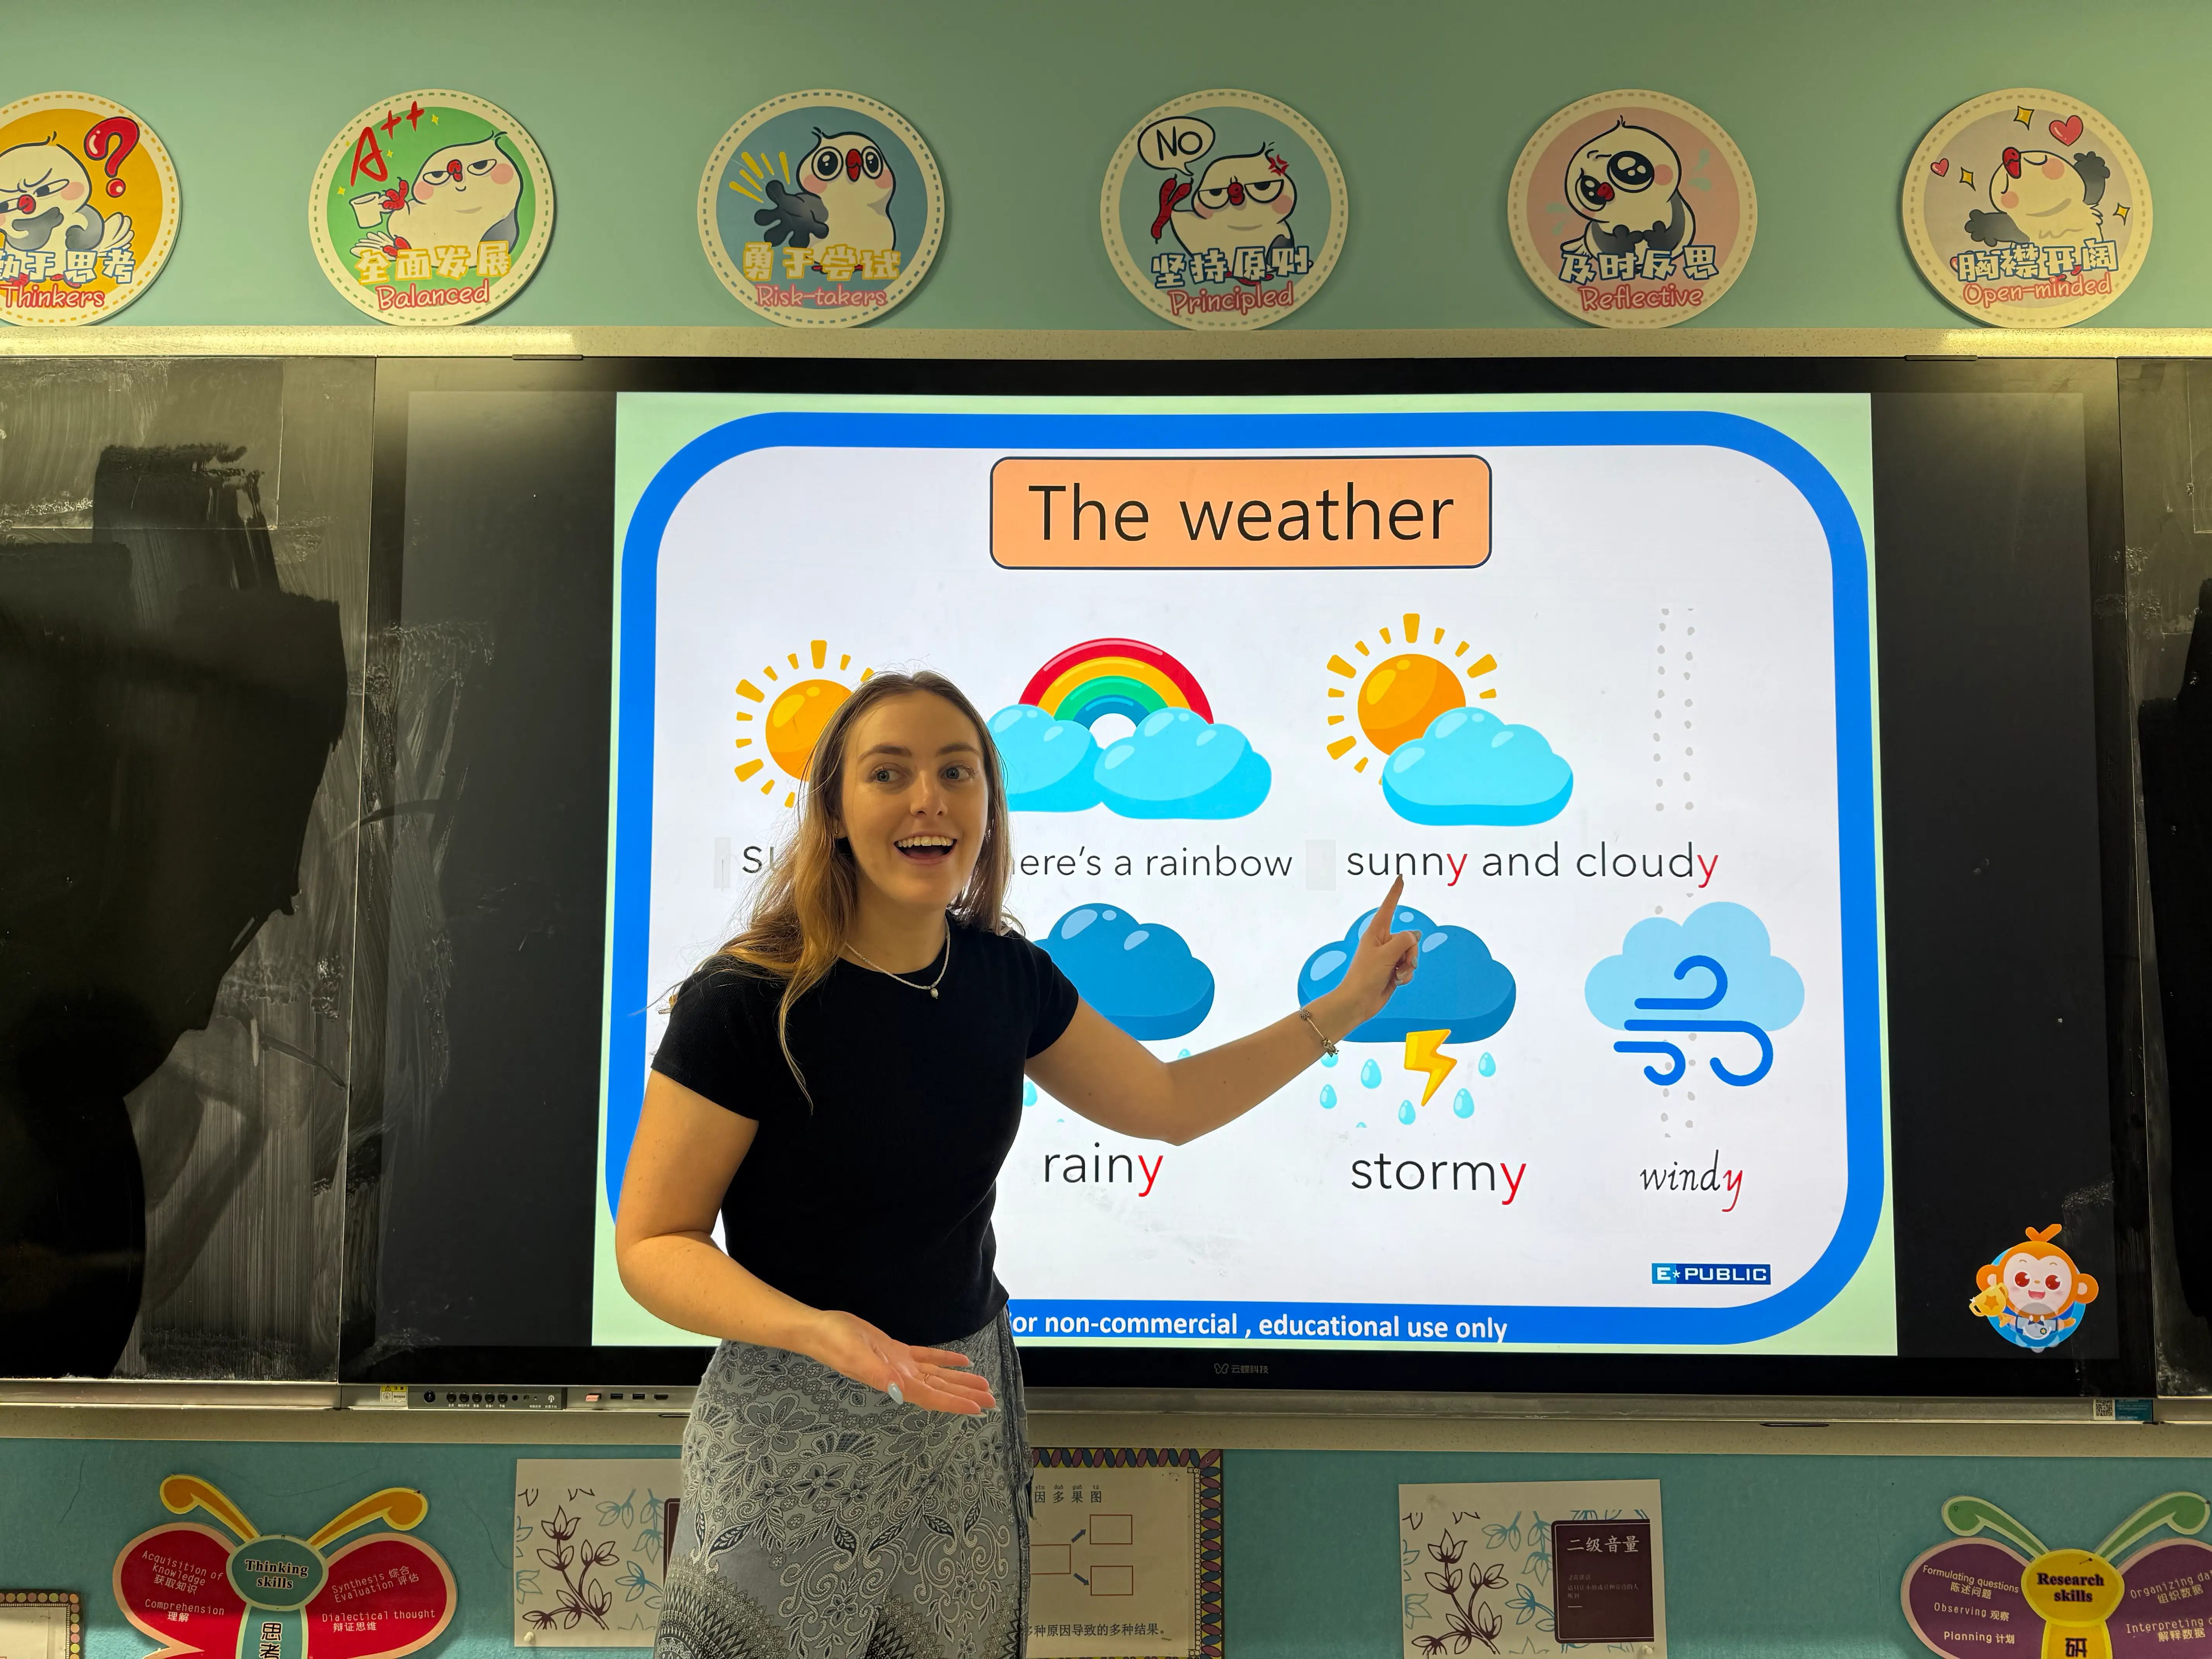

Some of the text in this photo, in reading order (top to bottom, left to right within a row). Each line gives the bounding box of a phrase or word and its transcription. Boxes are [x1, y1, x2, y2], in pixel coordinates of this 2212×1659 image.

[351, 101, 424, 187] A++
[1156, 126, 1202, 161] NO
[354, 240, 511, 285] 全面发展
[743, 242, 901, 281] 勇于尝试
[1151, 246, 1309, 289] 坚持原则
[1558, 245, 1719, 285] 及时反思
[1957, 238, 2119, 282] 胸襟开阔
[0, 283, 105, 308] Thinkers
[375, 278, 489, 310] Balanced
[756, 284, 887, 307] Risk-takers
[1168, 281, 1294, 316] Principled
[1578, 283, 1704, 311] Reflective
[1963, 271, 2112, 308] Open-minded
[1028, 482, 1453, 541] The weather
[1114, 854, 1132, 876] a
[1146, 845, 1293, 877] rainbow
[1346, 841, 1719, 888] sunny and cloudy
[1044, 1142, 1164, 1197] rainy
[1350, 1153, 1527, 1205] stormy
[1640, 1149, 1743, 1212] windy
[1009, 1312, 1038, 1333] or
[1045, 1312, 1237, 1336] non-commercial
[1259, 1313, 1399, 1338] educational
[1407, 1321, 1448, 1338] use
[1455, 1317, 1508, 1343] only
[1567, 1535, 1639, 1553] 二级音量
[142, 1550, 223, 1581] Acquisition of
[245, 1559, 309, 1577] Thinking
[1923, 1565, 2019, 1593] Formulating questions
[2037, 1573, 2105, 1586] Research
[154, 1574, 198, 1595] 获取知识
[257, 1576, 293, 1589] skills
[332, 1566, 410, 1594] Synthesis 综合
[335, 1573, 419, 1603] Evaluation 评估
[1950, 1582, 1992, 1599] 陈述问题
[2130, 1577, 2193, 1599] Organizing
[2157, 1584, 2204, 1604] 组织数据
[145, 1599, 224, 1615] Comprehension
[2054, 1589, 2093, 1602] skills
[167, 1611, 189, 1623] 理解
[322, 1609, 435, 1622] Dialectical thought
[1934, 1602, 2009, 1621] Observing 观察
[2126, 1618, 2204, 1633] Interpreting
[333, 1621, 377, 1633] 辩证思维
[1944, 1631, 2014, 1644] Planning 计划
[2158, 1628, 2206, 1642] 解释数据
